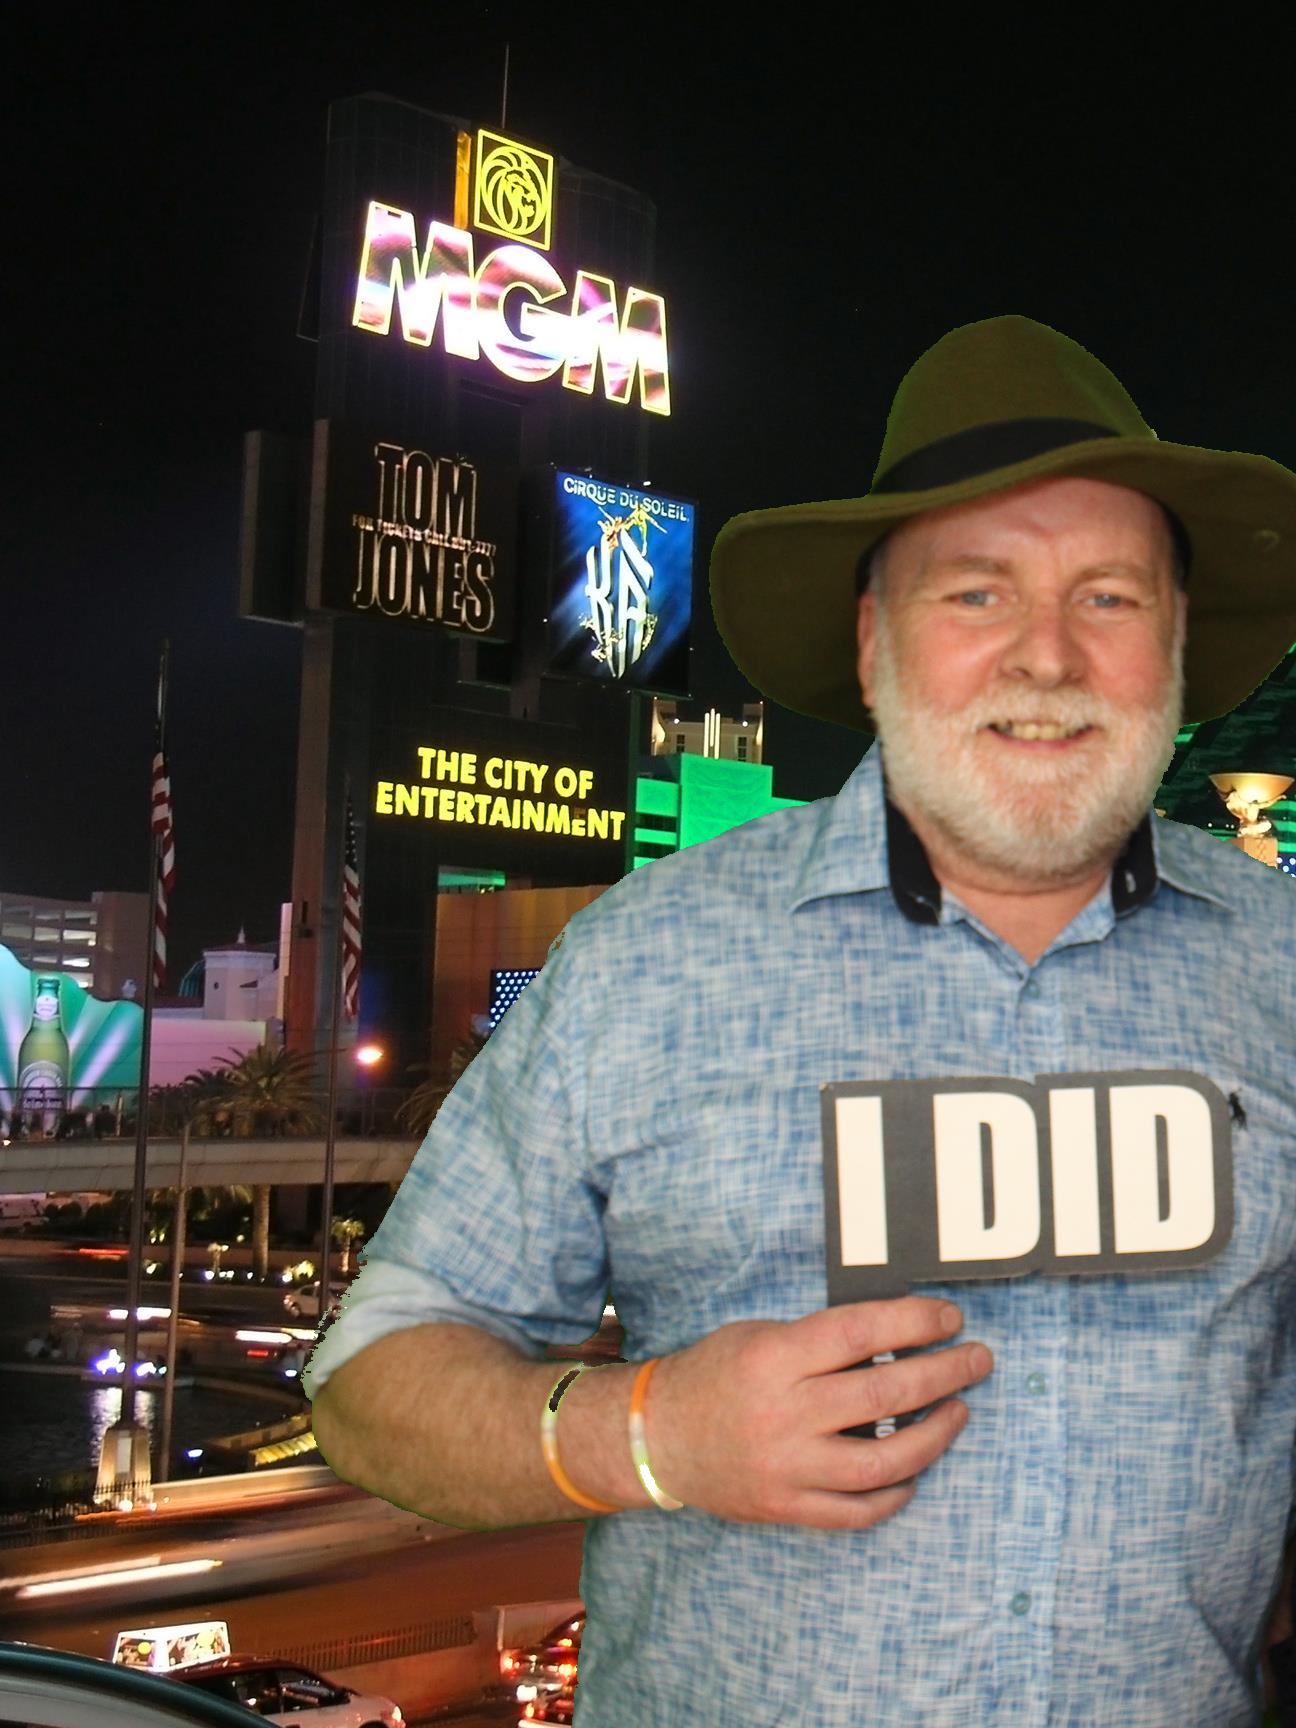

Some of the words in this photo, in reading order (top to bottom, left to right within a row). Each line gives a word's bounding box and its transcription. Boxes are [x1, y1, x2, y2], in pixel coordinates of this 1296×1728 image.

[352, 200, 671, 417] MGM
[374, 442, 477, 539] TOM
[619, 491, 638, 510] DU
[353, 528, 495, 632] JONES
[376, 781, 626, 841] ENTERTAINMENT
[417, 746, 477, 785] THE
[484, 757, 549, 794] CITY
[554, 767, 594, 800] OF
[835, 1095, 888, 1266] I
[932, 1084, 1216, 1262] DID
